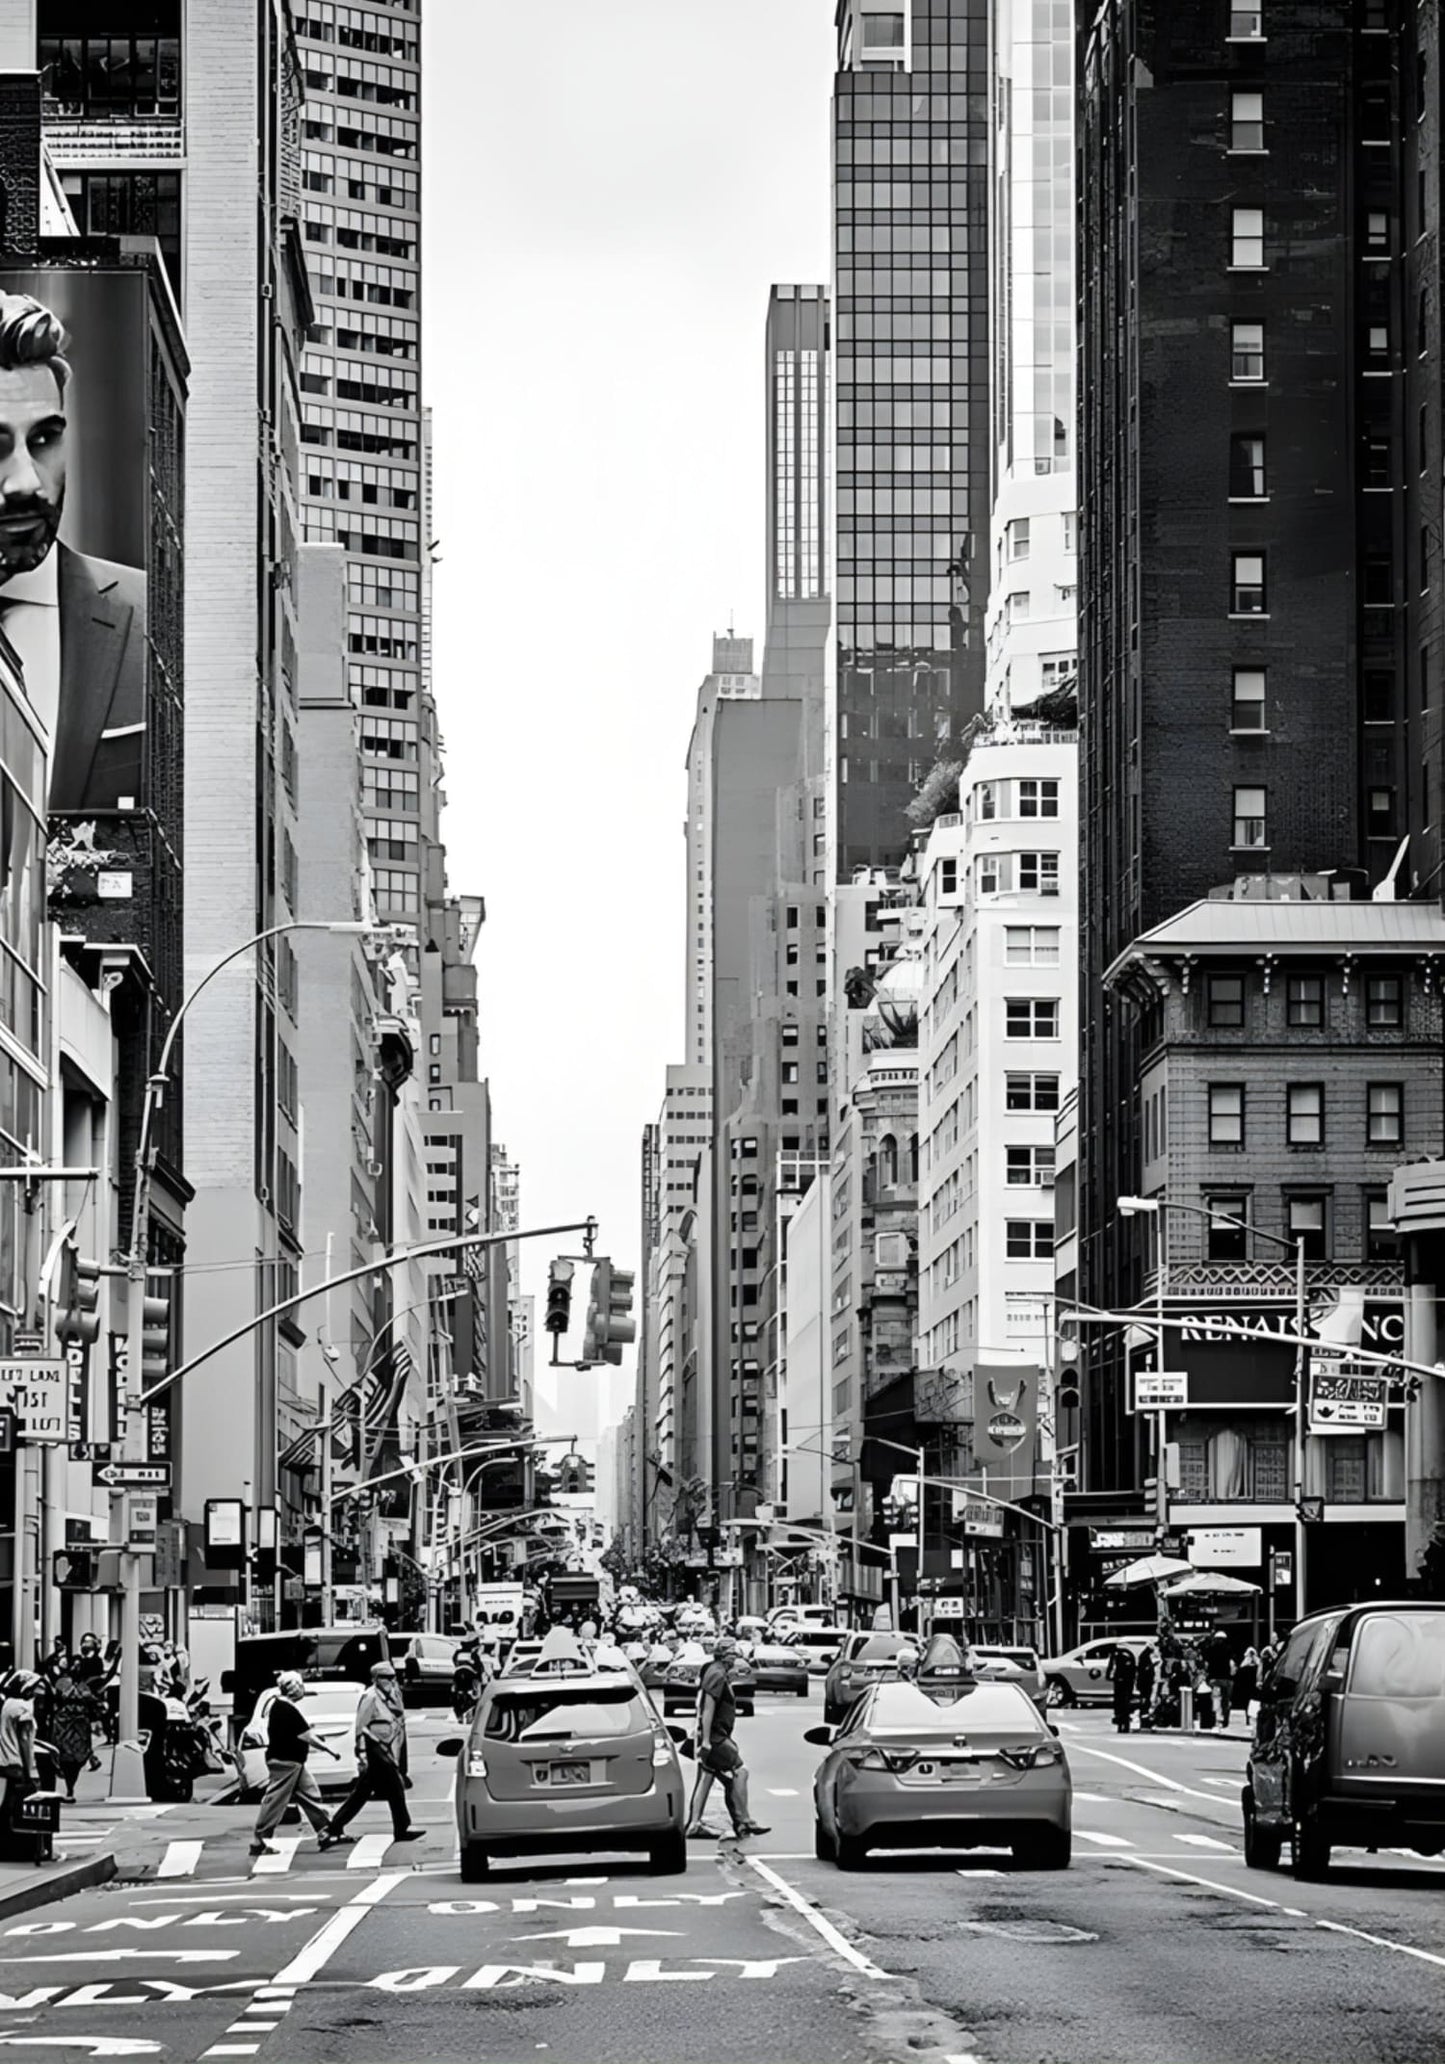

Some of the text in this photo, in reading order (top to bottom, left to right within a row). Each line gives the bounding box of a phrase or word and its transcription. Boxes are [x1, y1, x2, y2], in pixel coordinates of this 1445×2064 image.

[427, 1891, 755, 1914] ONLY
[4, 1907, 318, 1936] ONLY
[357, 1956, 812, 1991] ONLY
[0, 1979, 270, 2009] NLY
